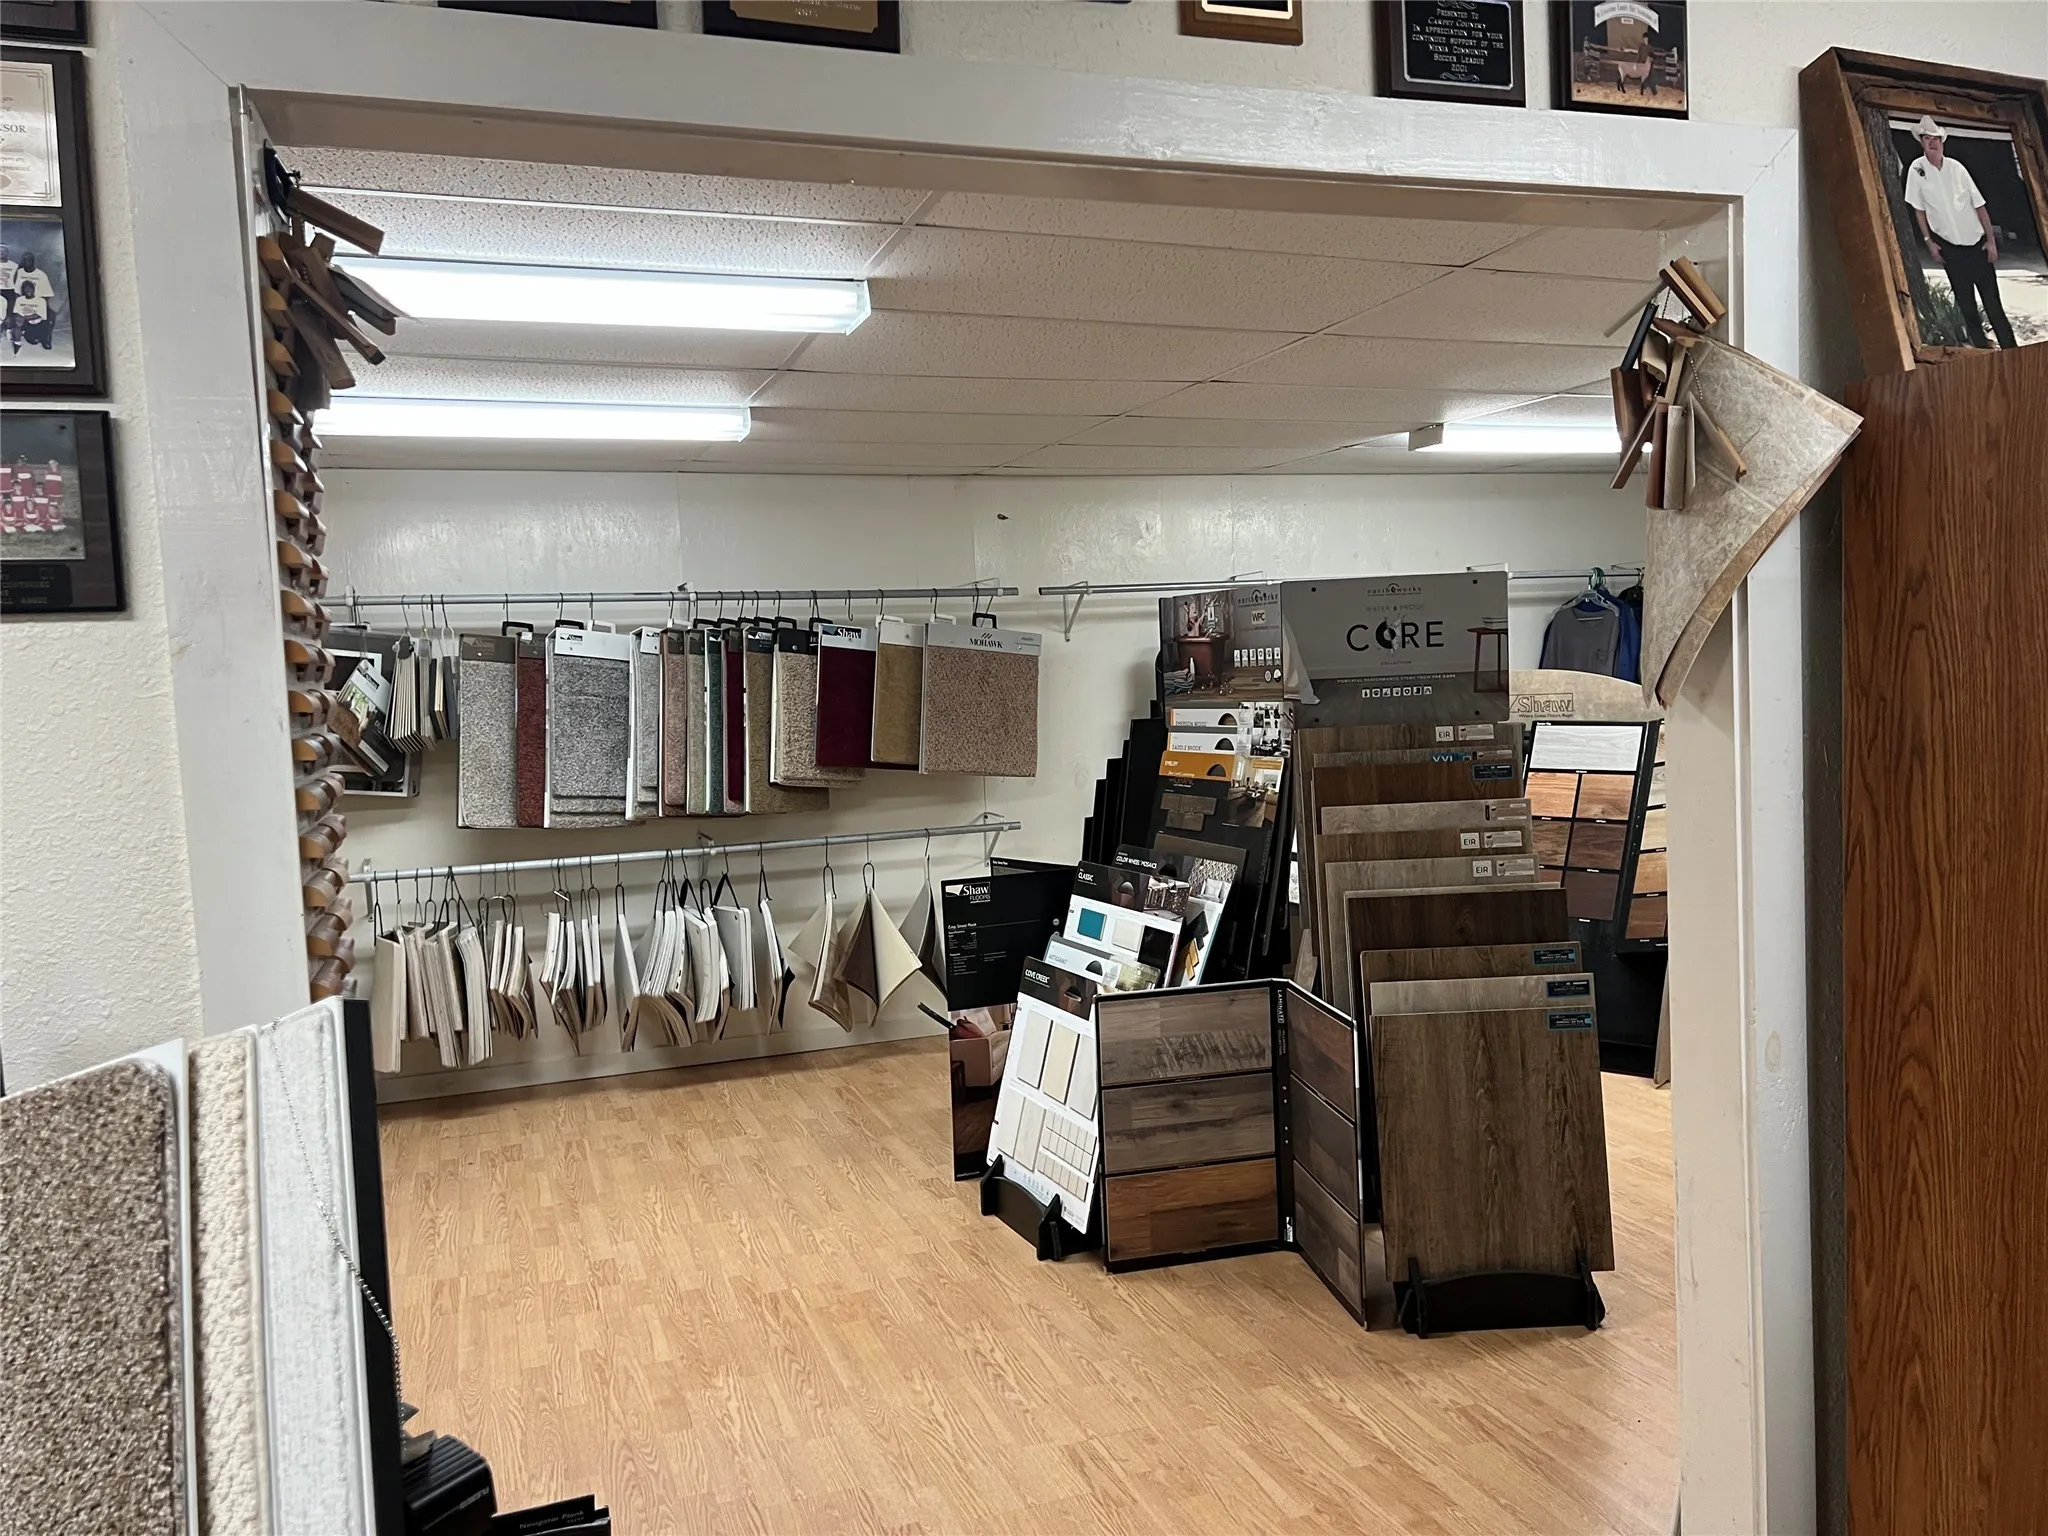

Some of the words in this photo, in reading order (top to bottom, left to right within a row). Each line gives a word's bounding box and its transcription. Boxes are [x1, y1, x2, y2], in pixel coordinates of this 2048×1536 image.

[1428, 17, 1454, 26] CARPET
[1456, 20, 1488, 30] COUNTRY
[1413, 24, 1421, 32] IN
[1425, 26, 1468, 37] APPRECIATION
[1487, 32, 1504, 40] YOUR
[1412, 34, 1446, 44] CONTINUED
[1450, 38, 1477, 47] SUPPORT
[1481, 40, 1489, 48] OF
[1492, 41, 1504, 50] THE
[1453, 46, 1489, 57] COMMUNITY
[1434, 53, 1457, 63] SOCCER
[1461, 56, 1485, 66] LEAGUE
[1451, 64, 1468, 73] 2001
[1252, 612, 1266, 622] WPC
[837, 628, 861, 639] Shaw
[1346, 621, 1445, 652] CORE
[969, 638, 1003, 648] MOHAWK
[1518, 696, 1572, 713] Shaw
[1464, 838, 1476, 846] EIR
[1476, 866, 1488, 874] EIR
[963, 885, 990, 896] Shaw
[1025, 969, 1036, 980] COVE
[520, 1516, 559, 1529] Navigator
[562, 1510, 584, 1520] Plank
